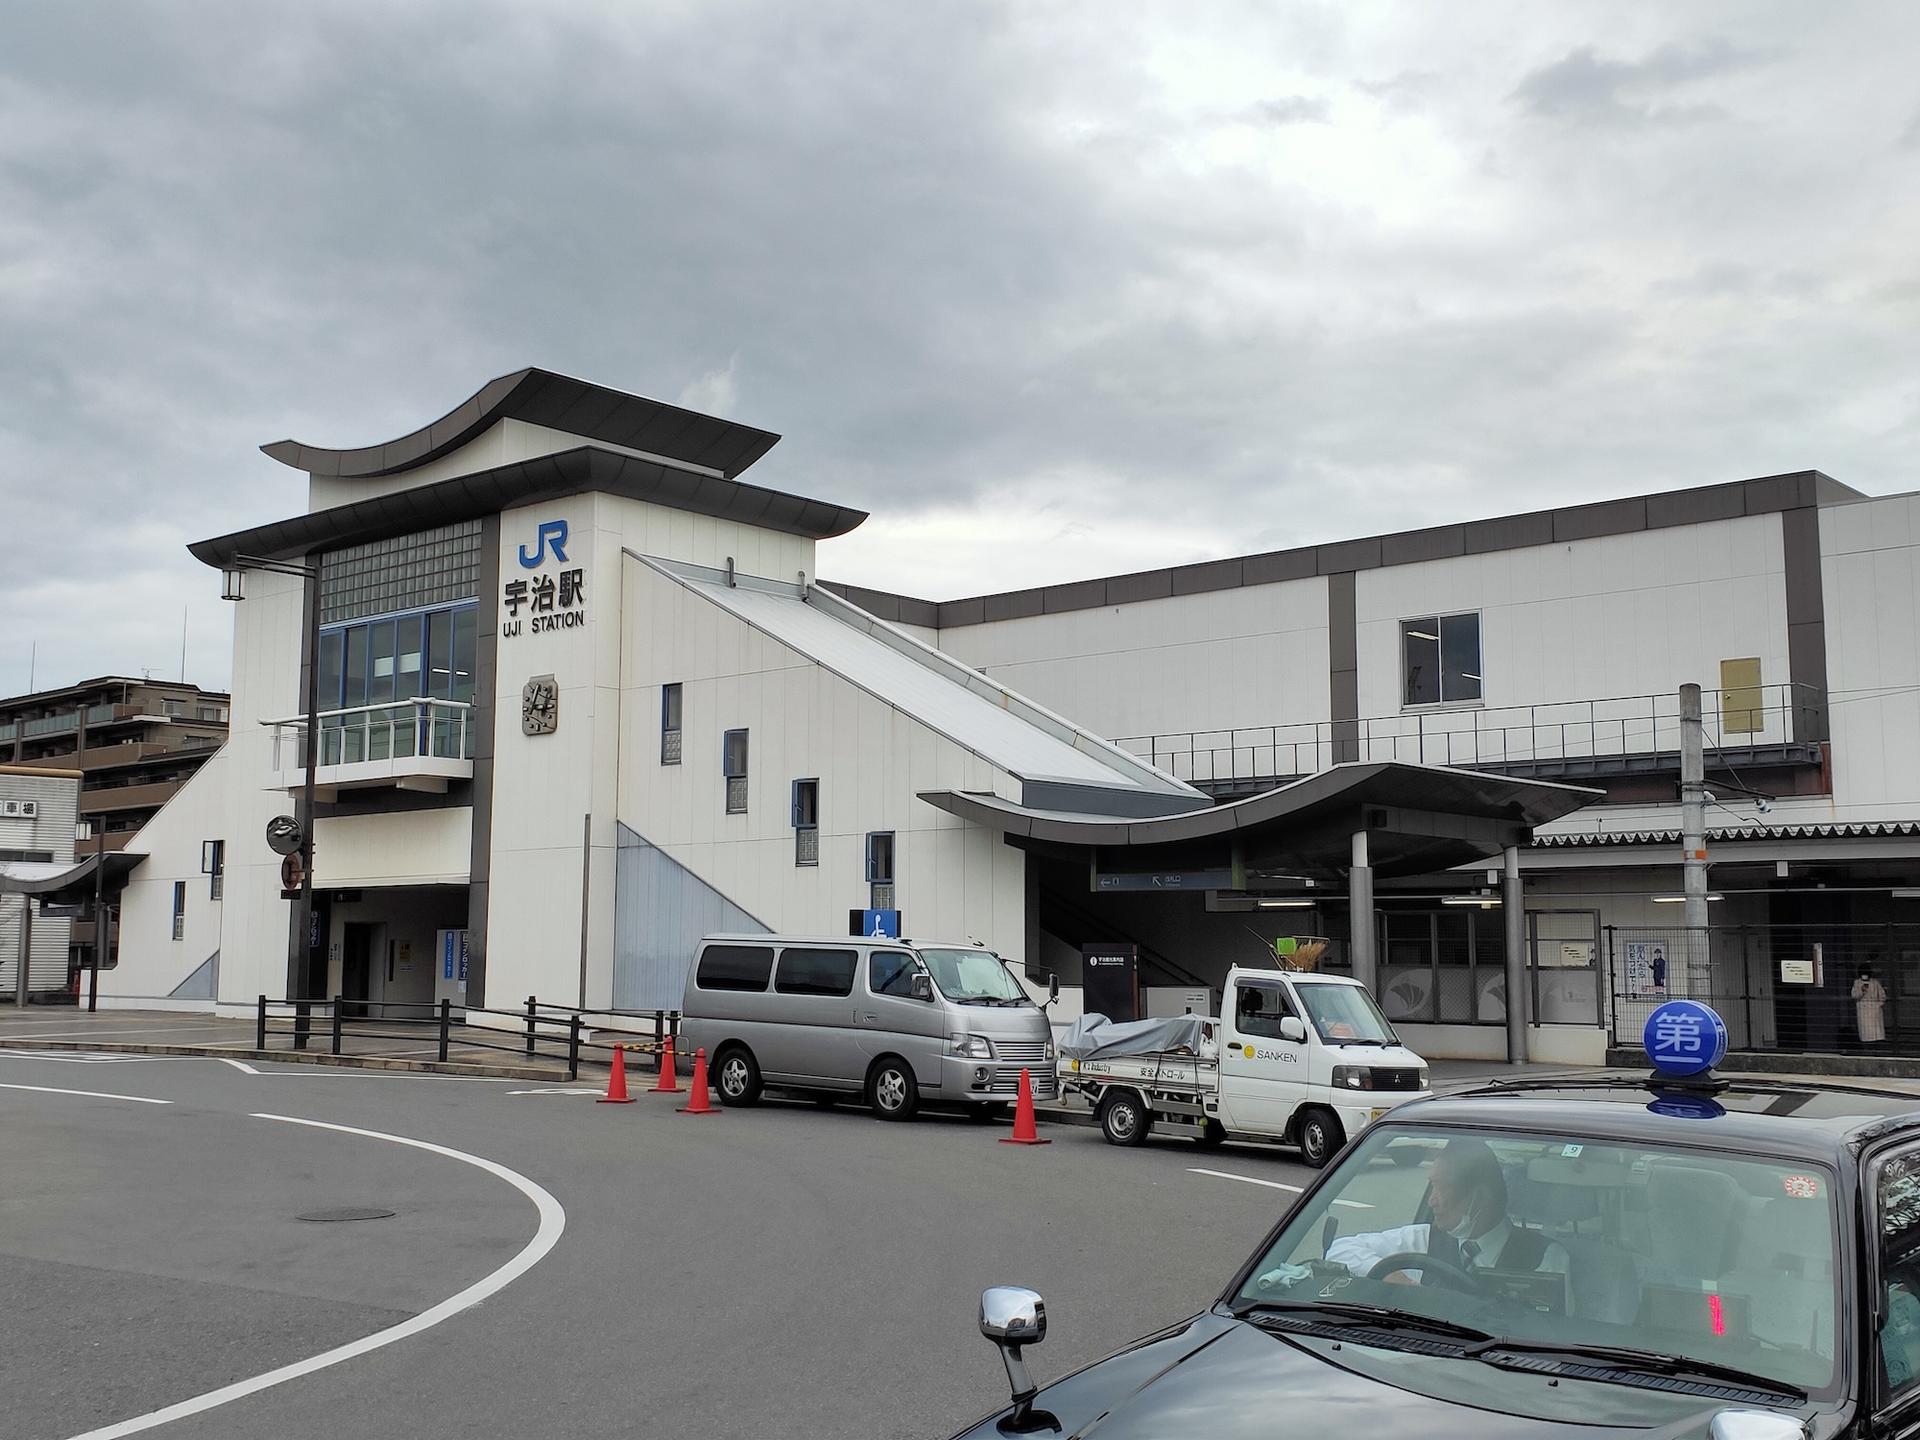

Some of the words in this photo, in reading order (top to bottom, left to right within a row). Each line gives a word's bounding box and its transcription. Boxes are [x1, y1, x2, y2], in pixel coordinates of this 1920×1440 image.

[519, 519, 569, 569] JR
[504, 568, 584, 618] 宇治駅
[503, 620, 522, 638] UJI
[531, 610, 585, 634] STATION
[0, 802, 34, 815] 車場
[1257, 1050, 1297, 1063] SANKEN
[1655, 1012, 1704, 1064] 第一
